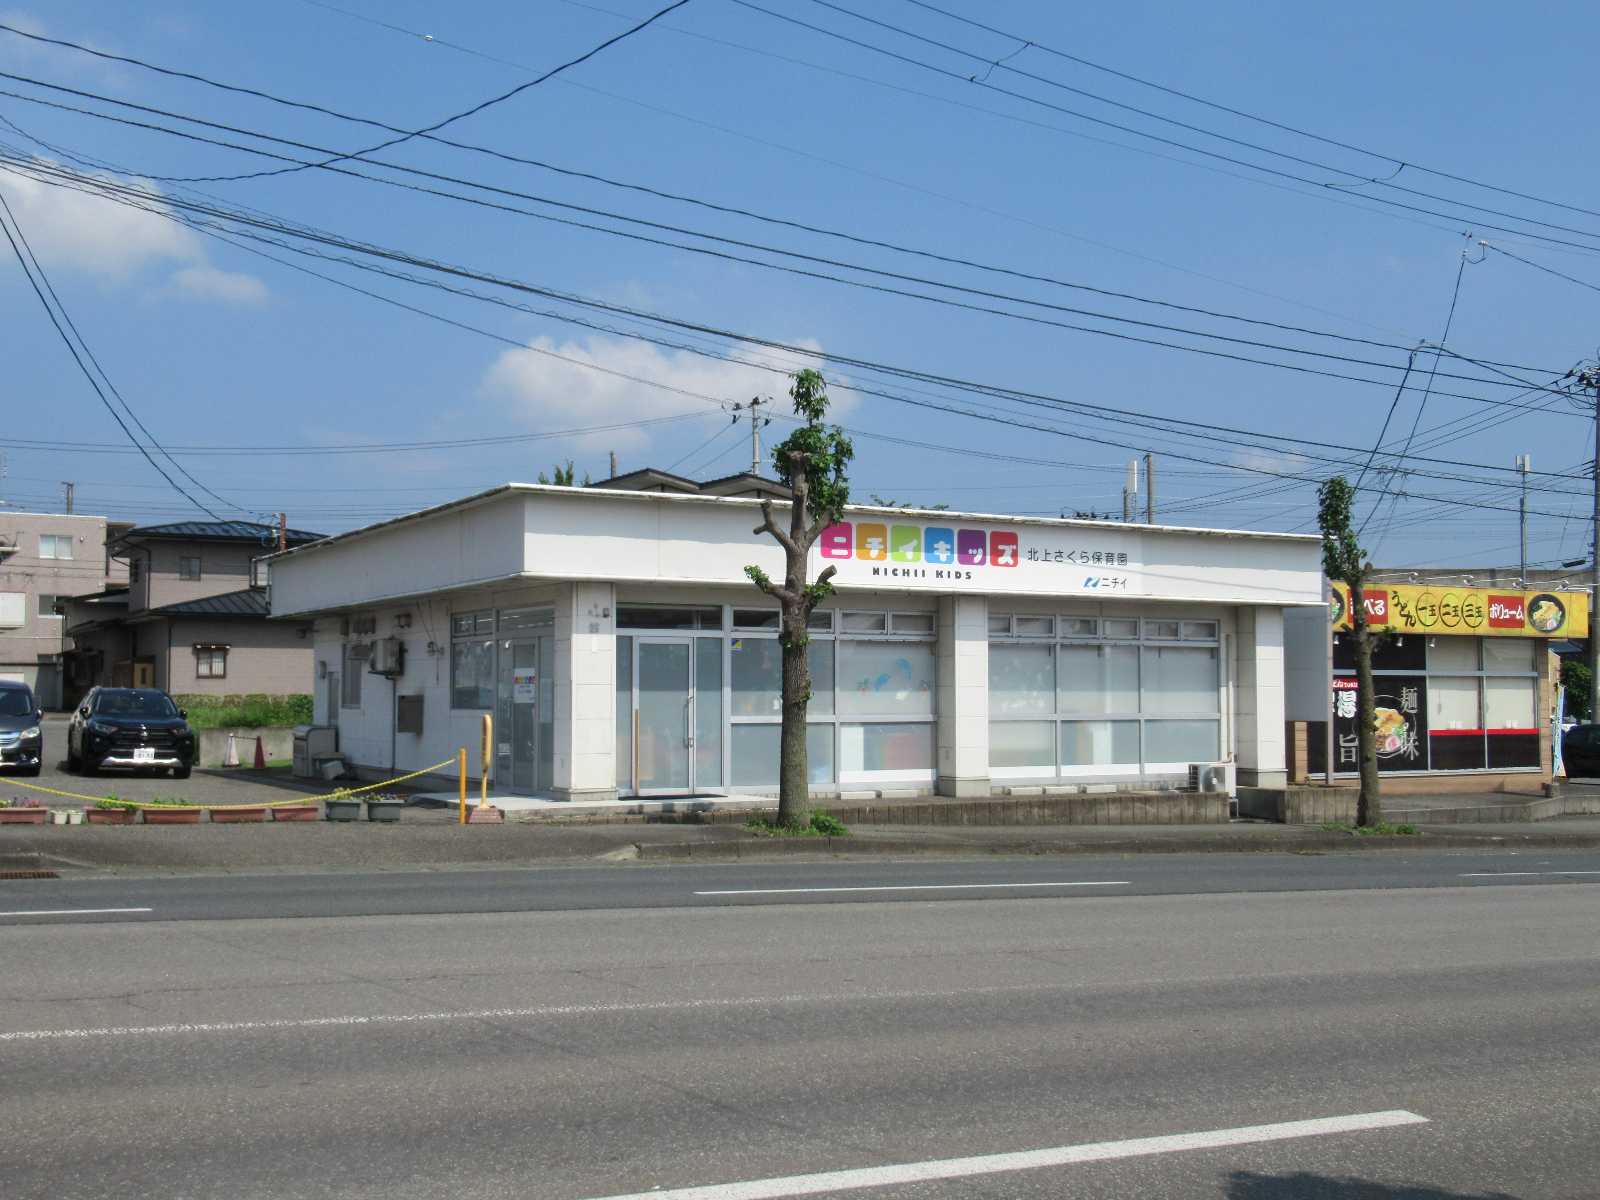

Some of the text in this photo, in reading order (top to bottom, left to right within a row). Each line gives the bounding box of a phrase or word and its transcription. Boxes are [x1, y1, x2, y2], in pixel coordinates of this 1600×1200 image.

[831, 536, 1017, 566] ニチイキッズ
[1027, 547, 1128, 566] 北上さくら保育園
[872, 567, 972, 580] NICHII KIDS
[1101, 577, 1128, 589] ニチイ
